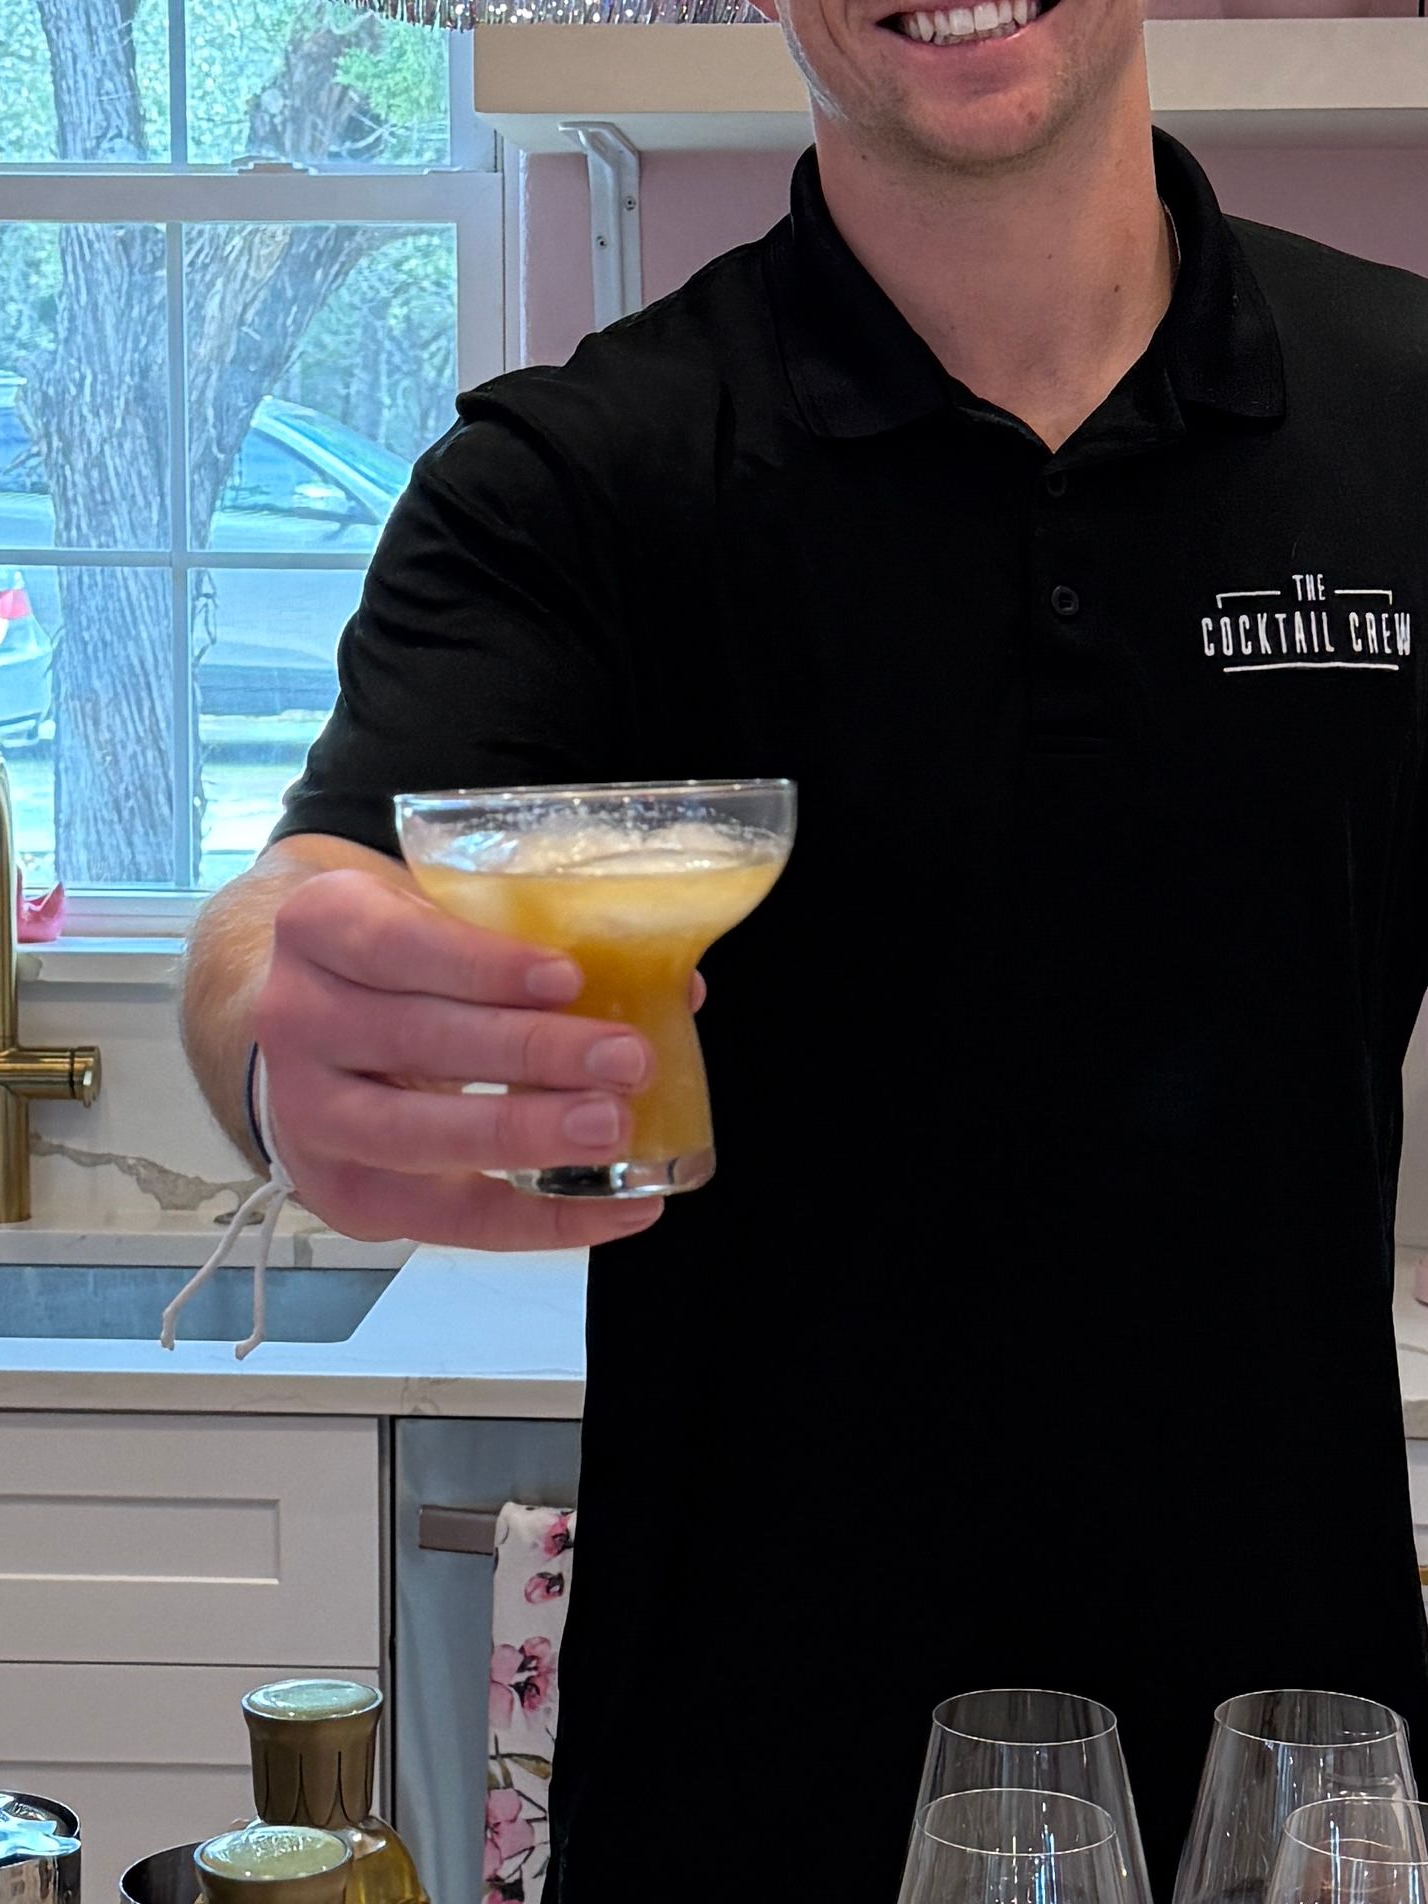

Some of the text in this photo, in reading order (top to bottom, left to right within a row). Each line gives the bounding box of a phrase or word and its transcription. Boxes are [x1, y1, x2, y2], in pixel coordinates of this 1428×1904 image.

[1292, 574, 1326, 601] THE
[1201, 611, 1411, 657] COCKTAIL CREW
